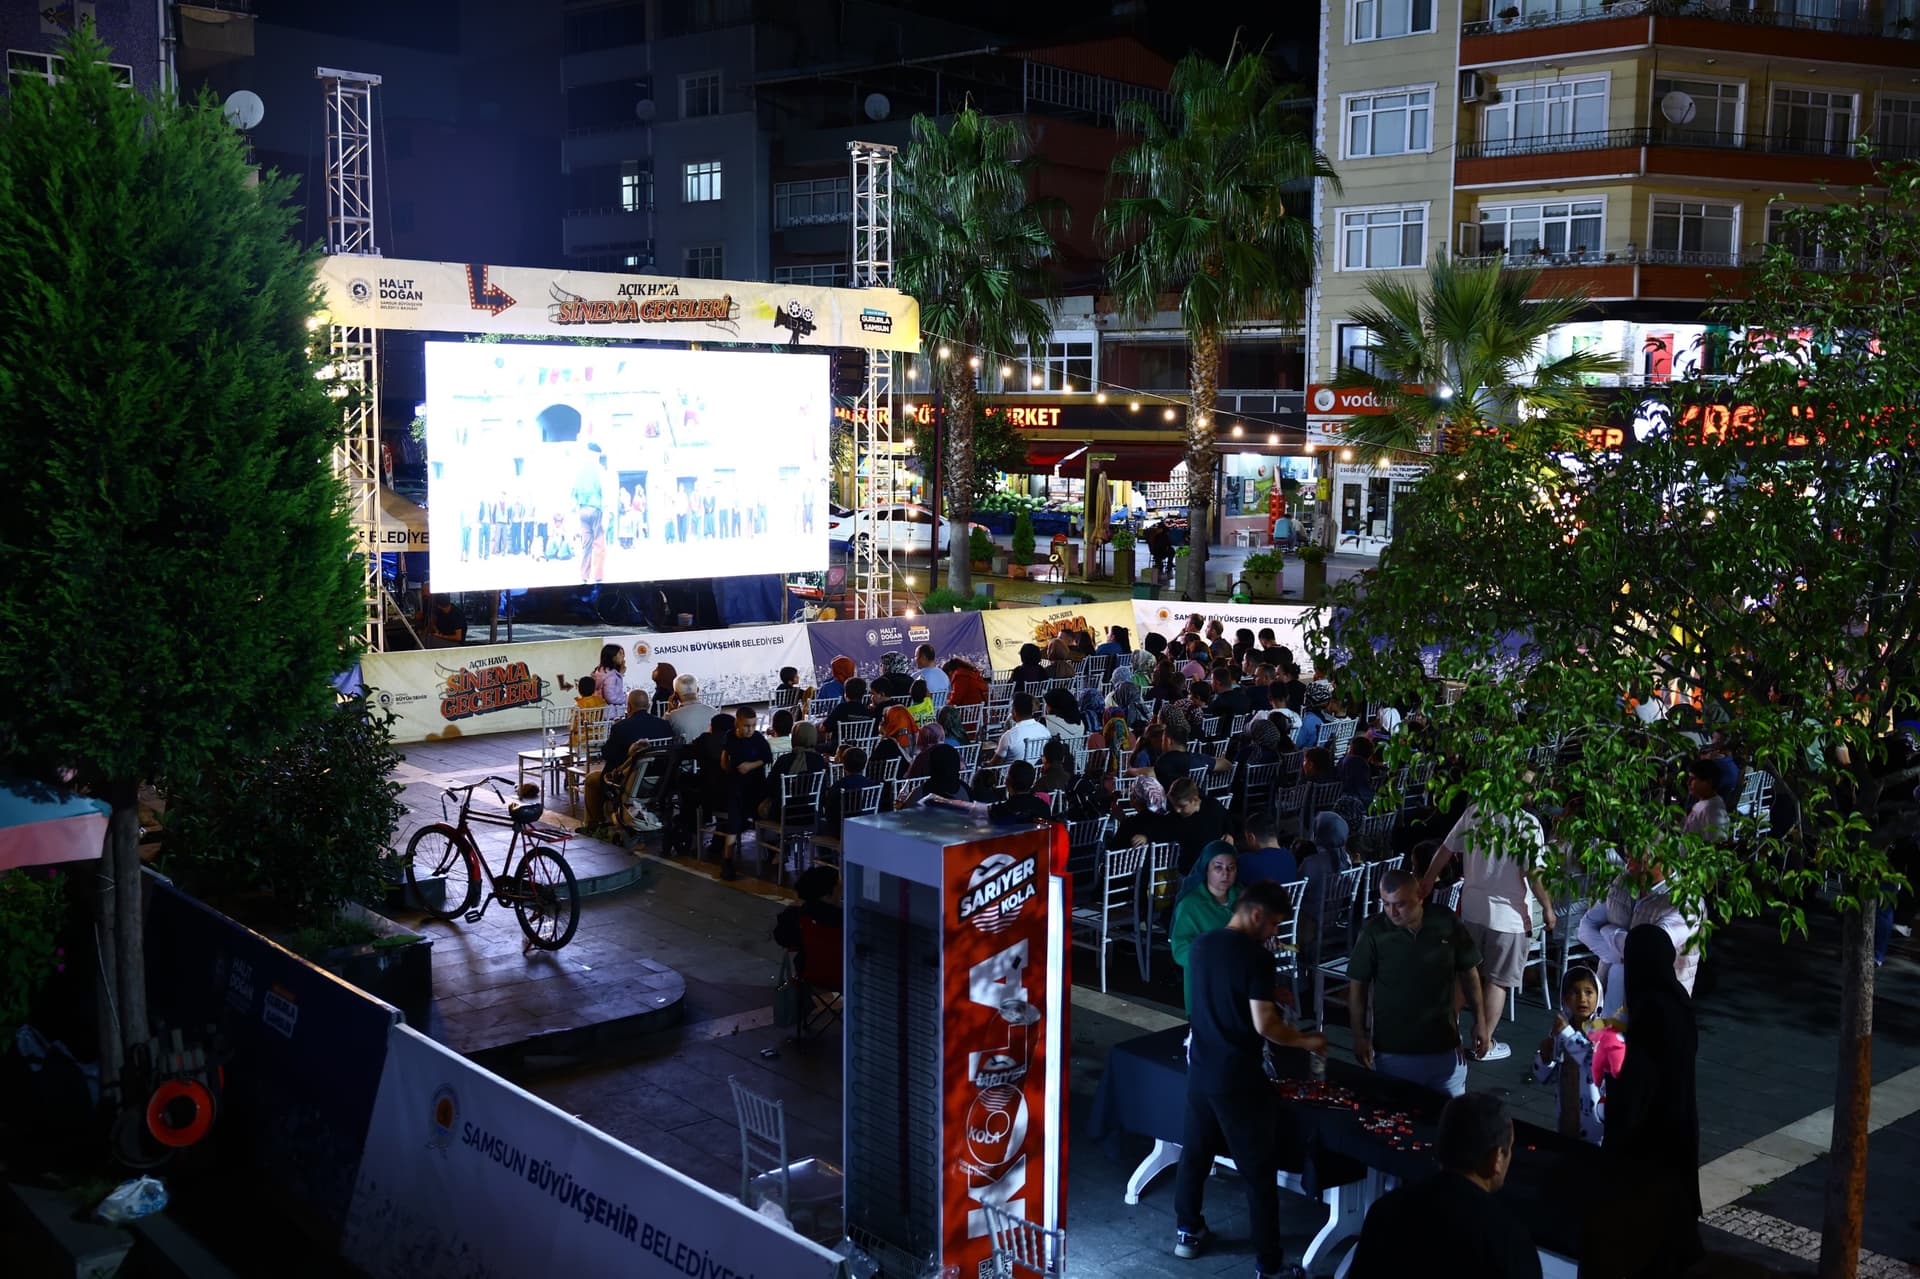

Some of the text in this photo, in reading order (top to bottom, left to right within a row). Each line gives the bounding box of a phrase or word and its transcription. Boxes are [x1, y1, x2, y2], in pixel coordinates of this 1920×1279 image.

[380, 289, 423, 301] DOĞAN
[617, 284, 679, 299] AÇIK HAVA
[558, 293, 731, 324] SİNEMA GECELERİ
[359, 529, 429, 544] BELEDİYE
[1259, 616, 1300, 625] BELEDİYE
[654, 634, 785, 655] SAMSUN BÜYÜKŞEHİR BELEDİYESİ
[469, 656, 508, 669] AÇIK HAVA
[446, 661, 531, 695] SİNEMA
[440, 673, 541, 721] GECELERİ
[960, 857, 1035, 917] SARIYER
[1001, 883, 1036, 914] KOLA
[968, 1126, 1000, 1144] KOLA
[462, 1121, 754, 1279] SAMSUN BÜYÜKŞEHİR BELEDİY
